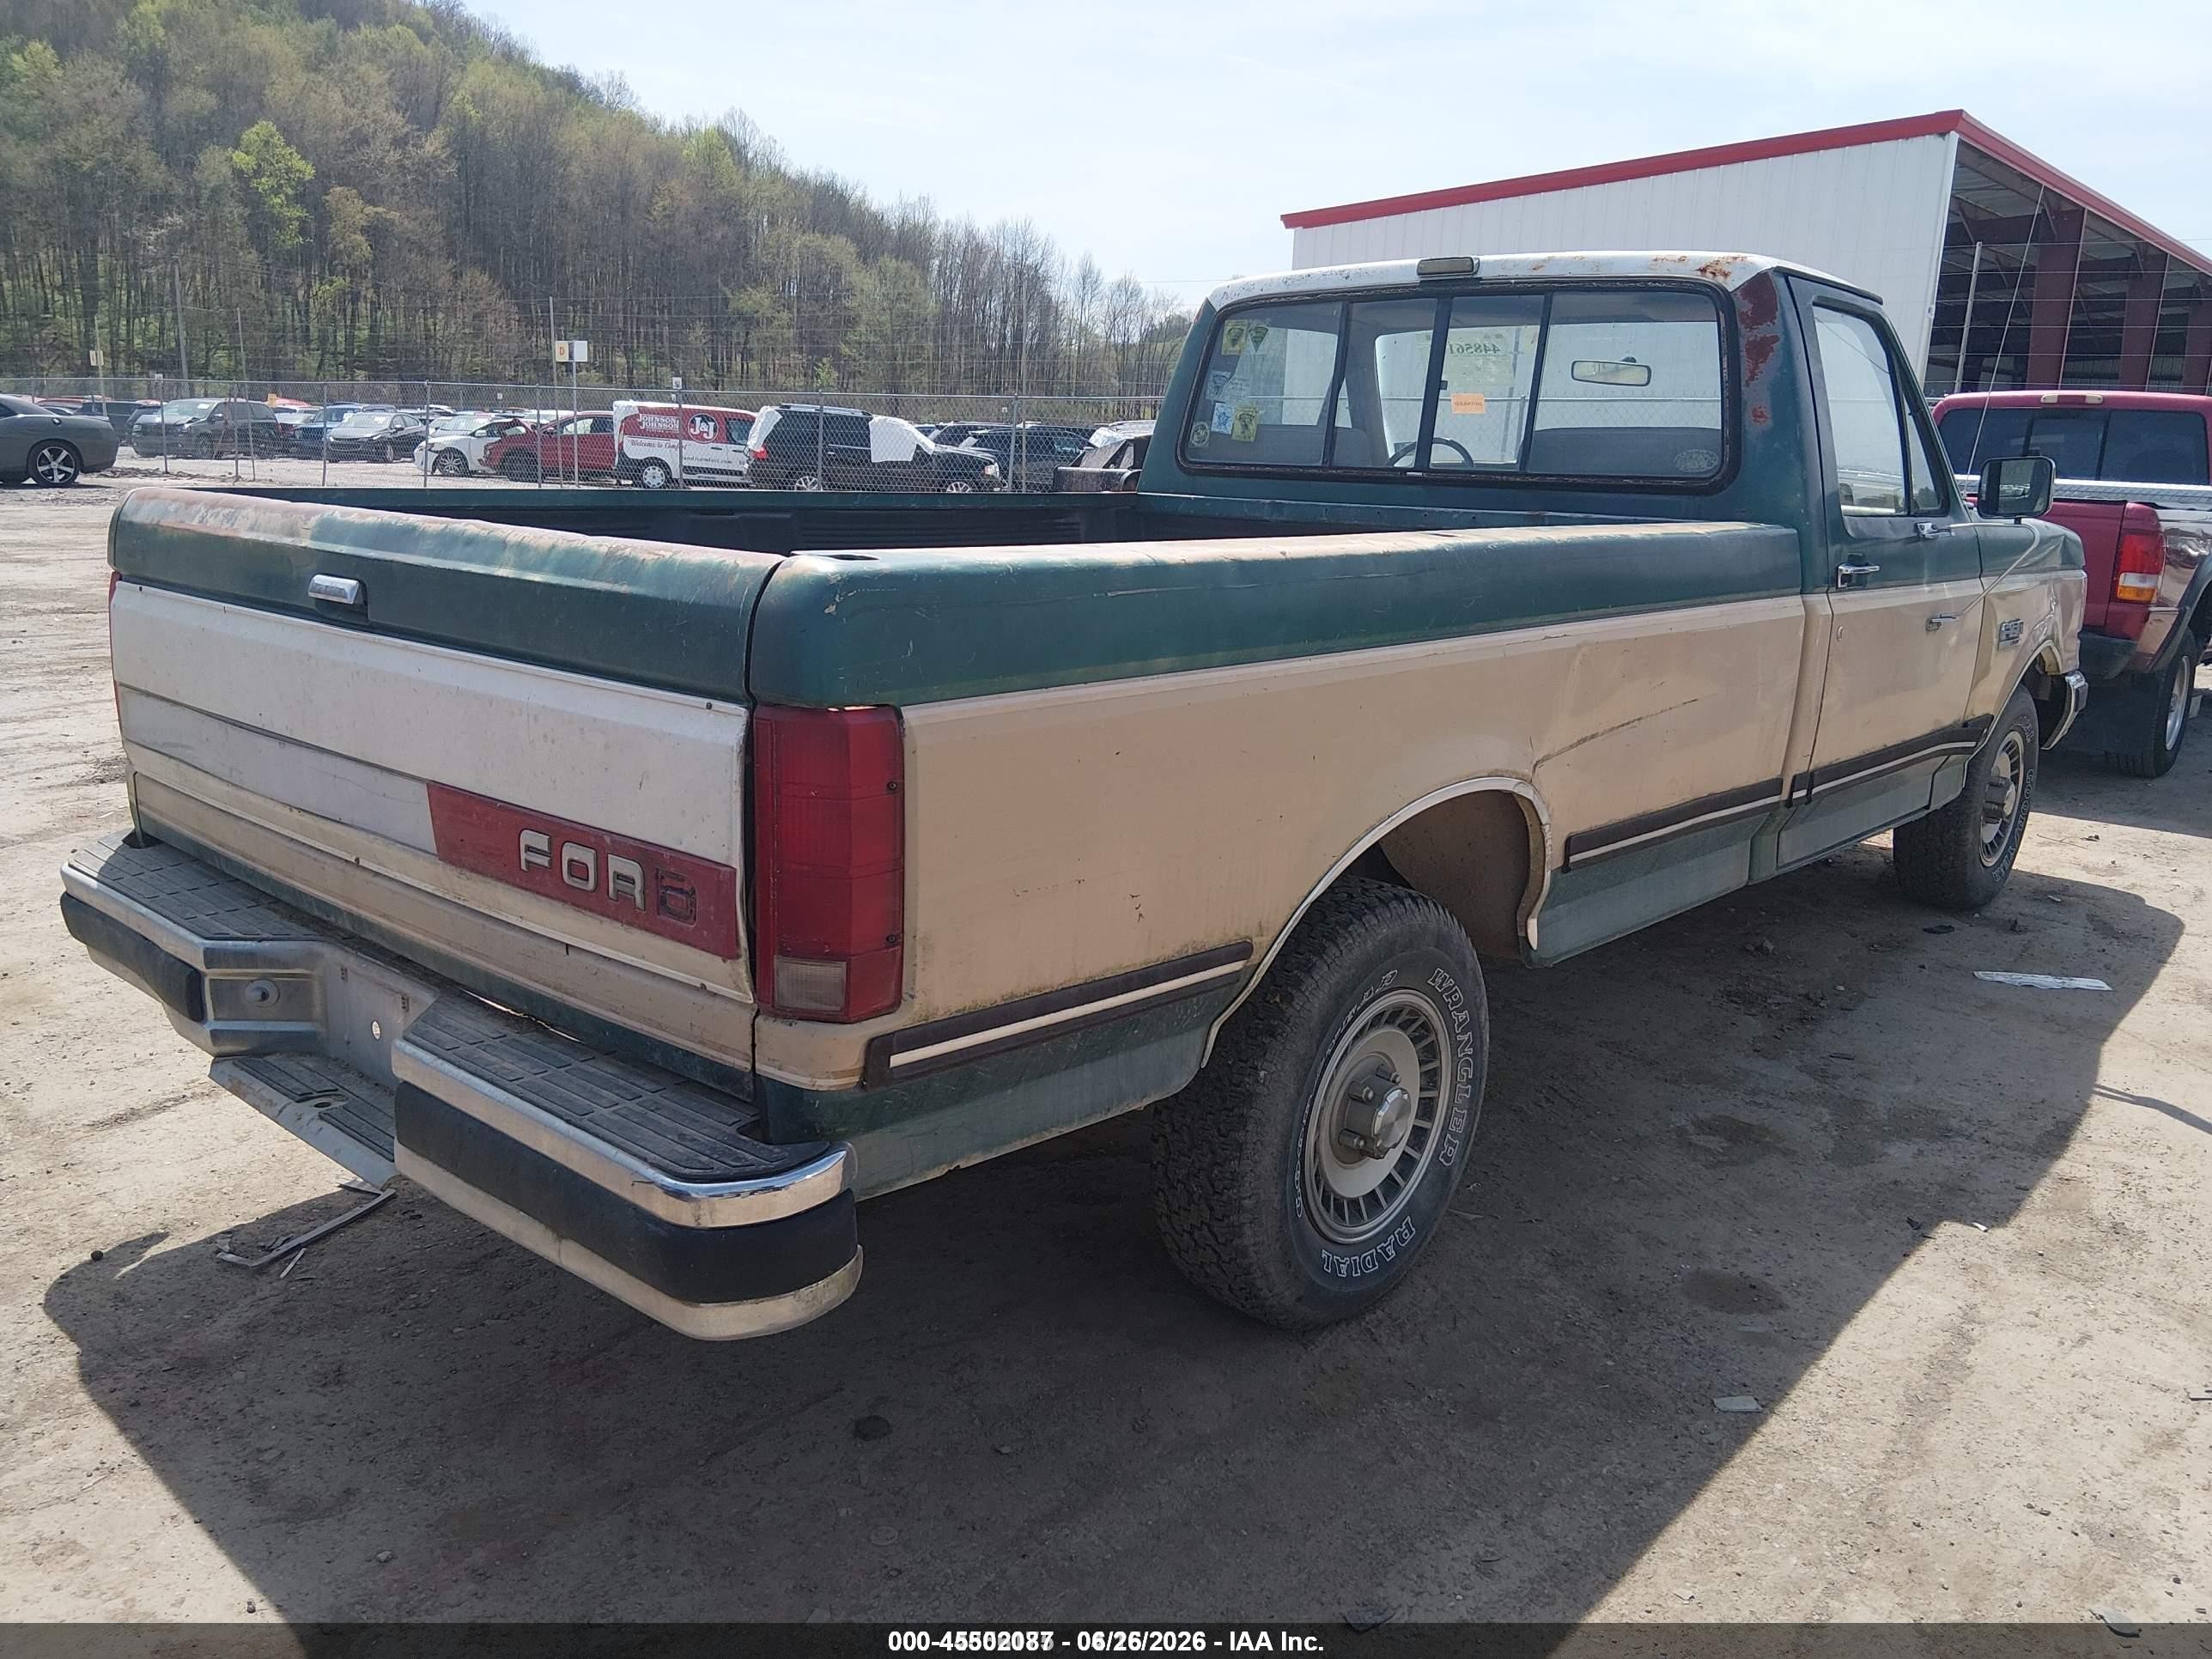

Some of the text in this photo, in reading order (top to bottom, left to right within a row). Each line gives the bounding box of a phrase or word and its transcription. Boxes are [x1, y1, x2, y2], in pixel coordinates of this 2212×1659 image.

[637, 414, 677, 424] JOHNSON
[640, 421, 679, 429] JOHNSON
[690, 417, 714, 440] J&J
[665, 442, 688, 451] Comfrt
[1427, 968, 1474, 1166] WRANGLER
[1322, 1216, 1416, 1277] RADIAL
